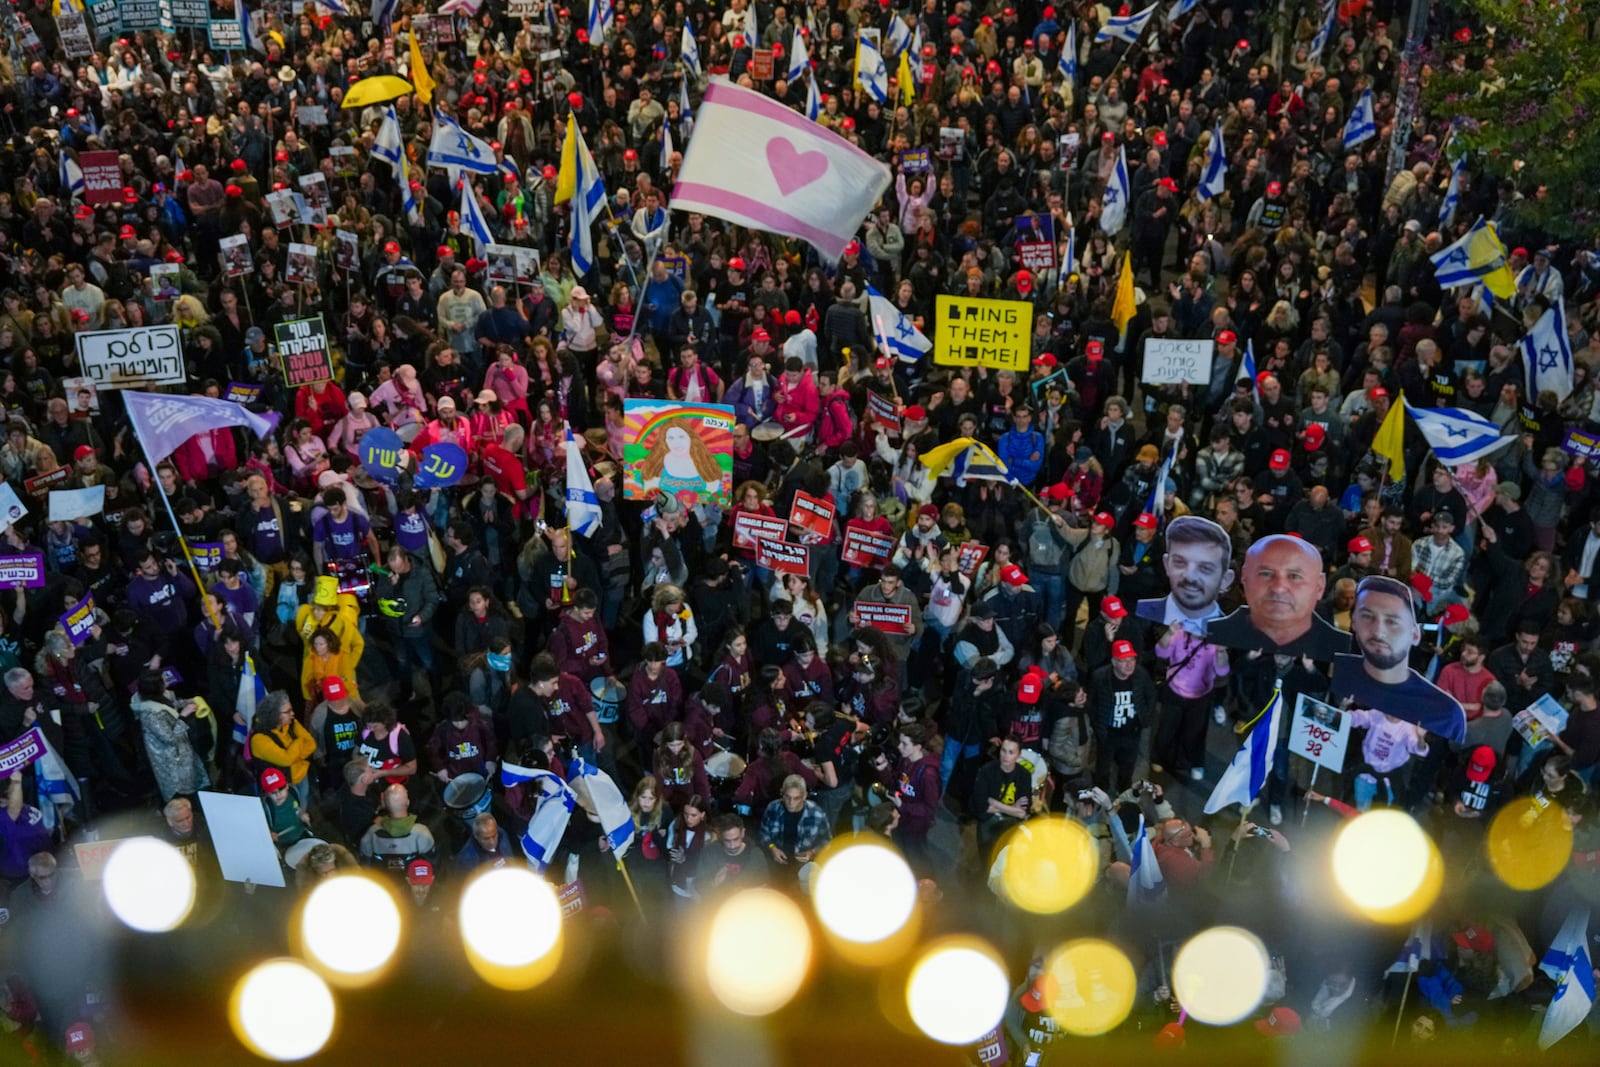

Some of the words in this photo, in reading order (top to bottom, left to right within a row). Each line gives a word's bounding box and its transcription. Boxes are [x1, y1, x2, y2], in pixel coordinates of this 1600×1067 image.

[86, 179, 121, 190] WAR
[1023, 257, 1053, 268] WAR
[949, 304, 1017, 324] BRING
[288, 321, 311, 340] סוף
[107, 331, 175, 359] כולם
[949, 344, 1018, 367] HOME!
[857, 605, 883, 613] ISRAELIS
[884, 607, 908, 615] CHOOSE
[873, 614, 905, 623] HOSTAGES!
[1304, 723, 1331, 742] 100
[1305, 739, 1323, 757] 98
